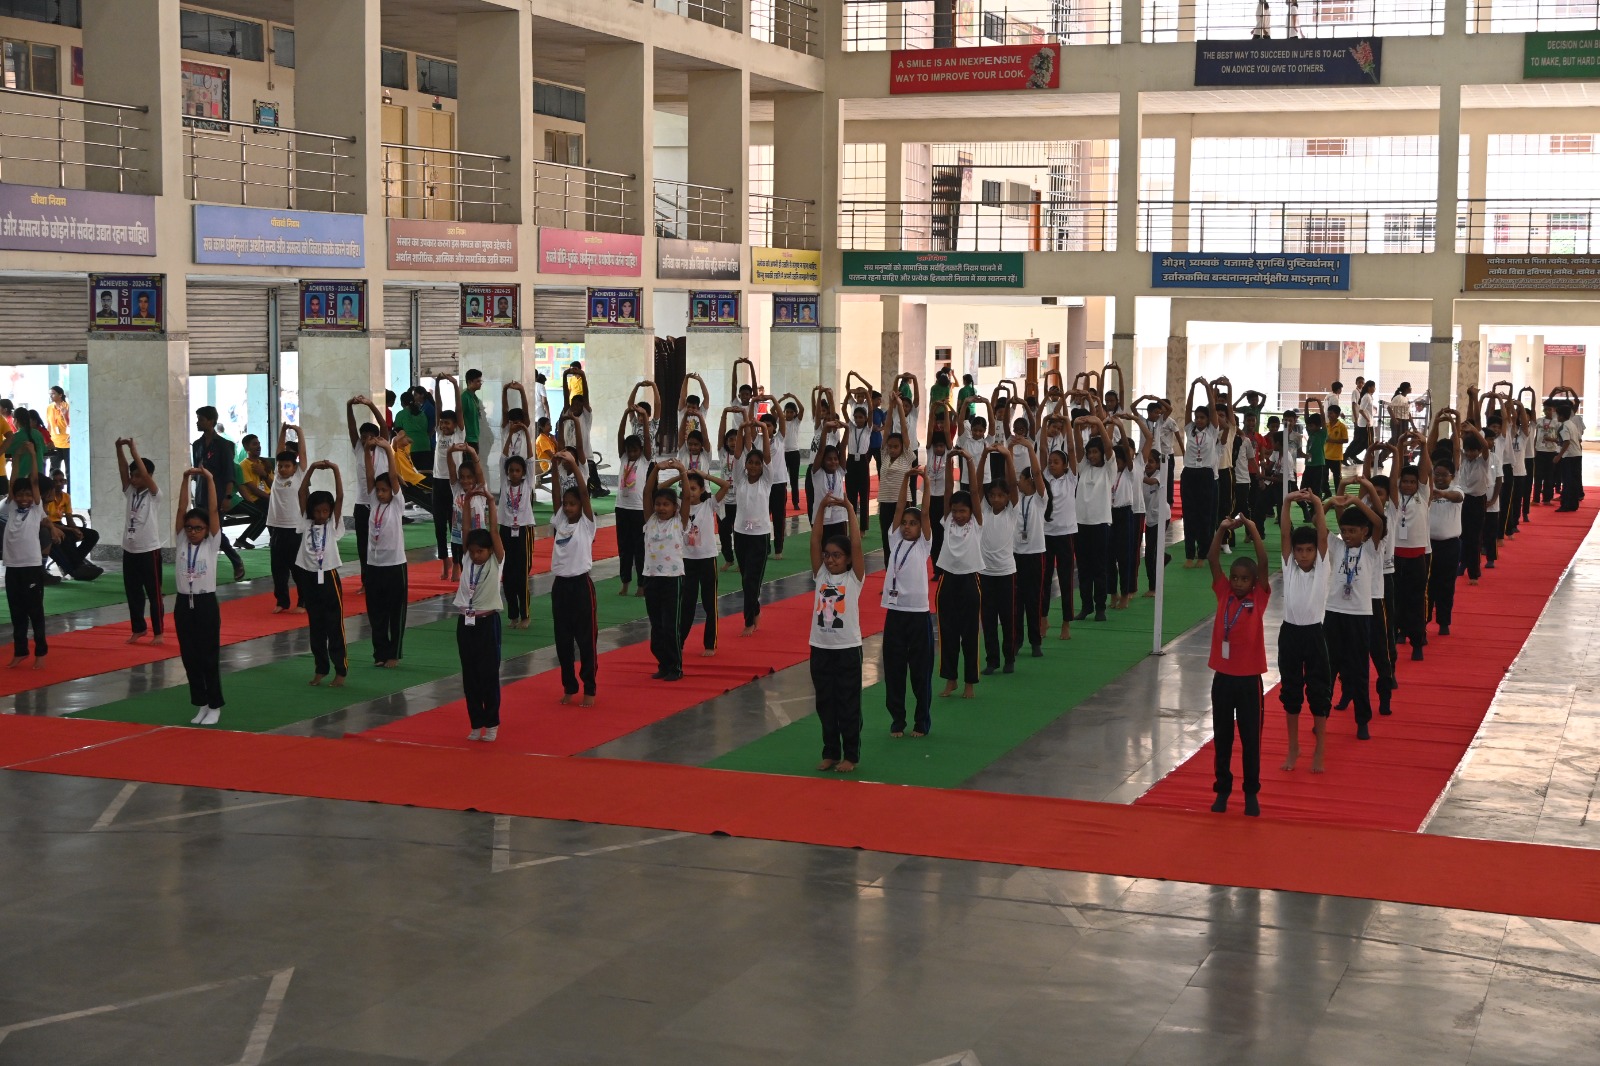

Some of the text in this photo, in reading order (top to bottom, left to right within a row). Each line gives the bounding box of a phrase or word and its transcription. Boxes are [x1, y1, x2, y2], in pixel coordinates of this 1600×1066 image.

[1547, 40, 1578, 49] DECISION
[1579, 40, 1592, 48] CAN
[1203, 51, 1216, 60] THE
[1217, 51, 1233, 60] BEST
[1234, 51, 1248, 60] WAY
[1250, 51, 1259, 59] TO
[1260, 50, 1290, 59] SUCCEED
[1292, 50, 1298, 58] IN
[1332, 50, 1346, 58] ACT
[898, 56, 1022, 68] A SMILE IS AN INEXPENSIVE
[1530, 57, 1540, 66] TO
[1540, 56, 1560, 67] MAKE,
[1562, 56, 1576, 66] BUT
[1577, 56, 1594, 66] HARD
[1221, 64, 1326, 74] ON ADVICE YOU GIVE TO OTHERS.
[896, 70, 1026, 83] WAY TO IMPROVE YOUR LOOK.
[31, 192, 66, 206] चौथा नियम
[4, 211, 17, 236] और
[18, 220, 40, 237] असत्य
[41, 215, 49, 238] के
[77, 218, 95, 242] सर्वदा
[112, 226, 128, 244] रहना
[893, 262, 902, 271] को
[902, 262, 928, 272] सामाजिक
[963, 263, 978, 272] नियम
[980, 264, 996, 272] पालने
[1224, 258, 1254, 268] यजामहे
[1287, 258, 1334, 270] पुष्टिवर्धनम्
[882, 273, 898, 282] चाहिए
[900, 273, 910, 282] और
[912, 273, 928, 282] प्रत्येक
[954, 274, 970, 282] नियम
[1162, 272, 1210, 282] उर्वारुकमिव
[120, 316, 130, 325] XII
[326, 316, 336, 324] XII
